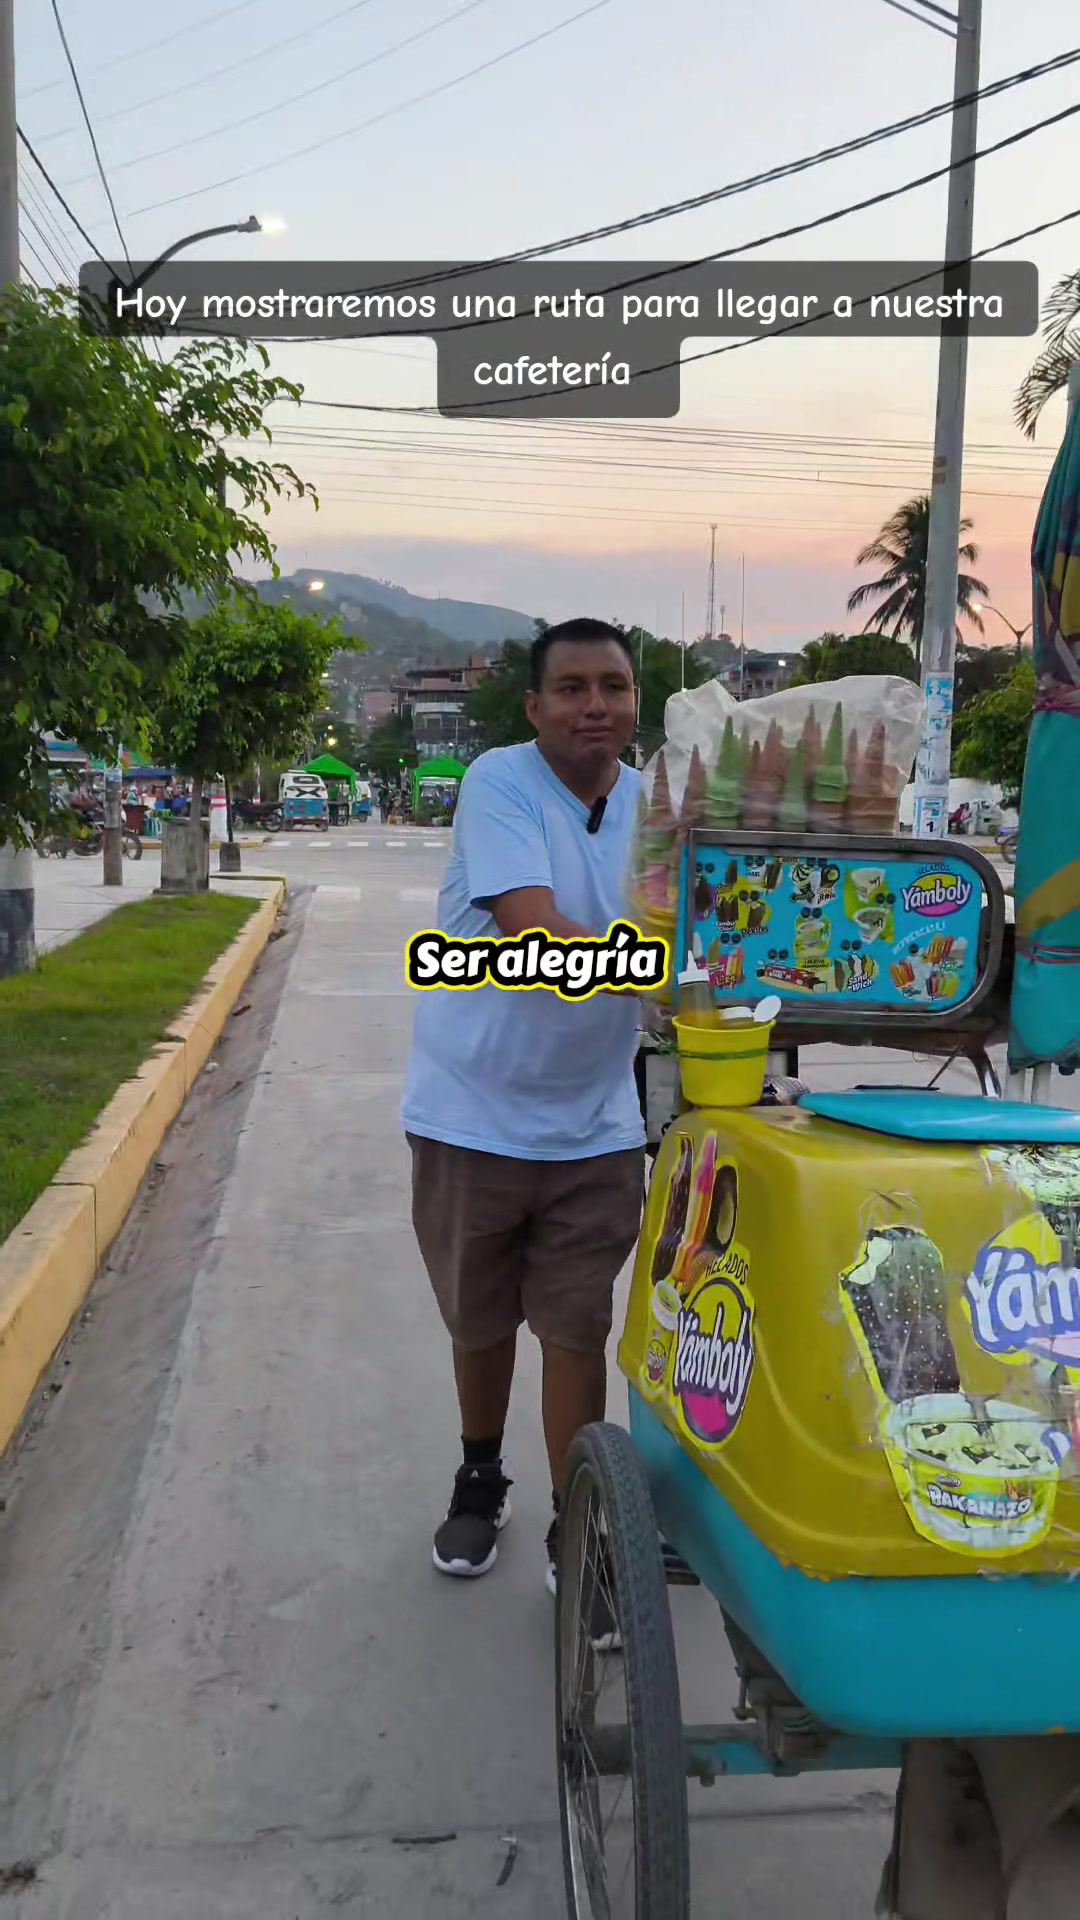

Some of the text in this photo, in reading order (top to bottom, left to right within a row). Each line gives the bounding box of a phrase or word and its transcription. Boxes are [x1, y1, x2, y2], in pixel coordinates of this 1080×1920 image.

[902, 874, 972, 911] Yámboly
[848, 971, 869, 986] Sand
[705, 1252, 749, 1286] HELADOS
[673, 1301, 753, 1417] Yámboly
[928, 1483, 1032, 1519] BAKANAZO
